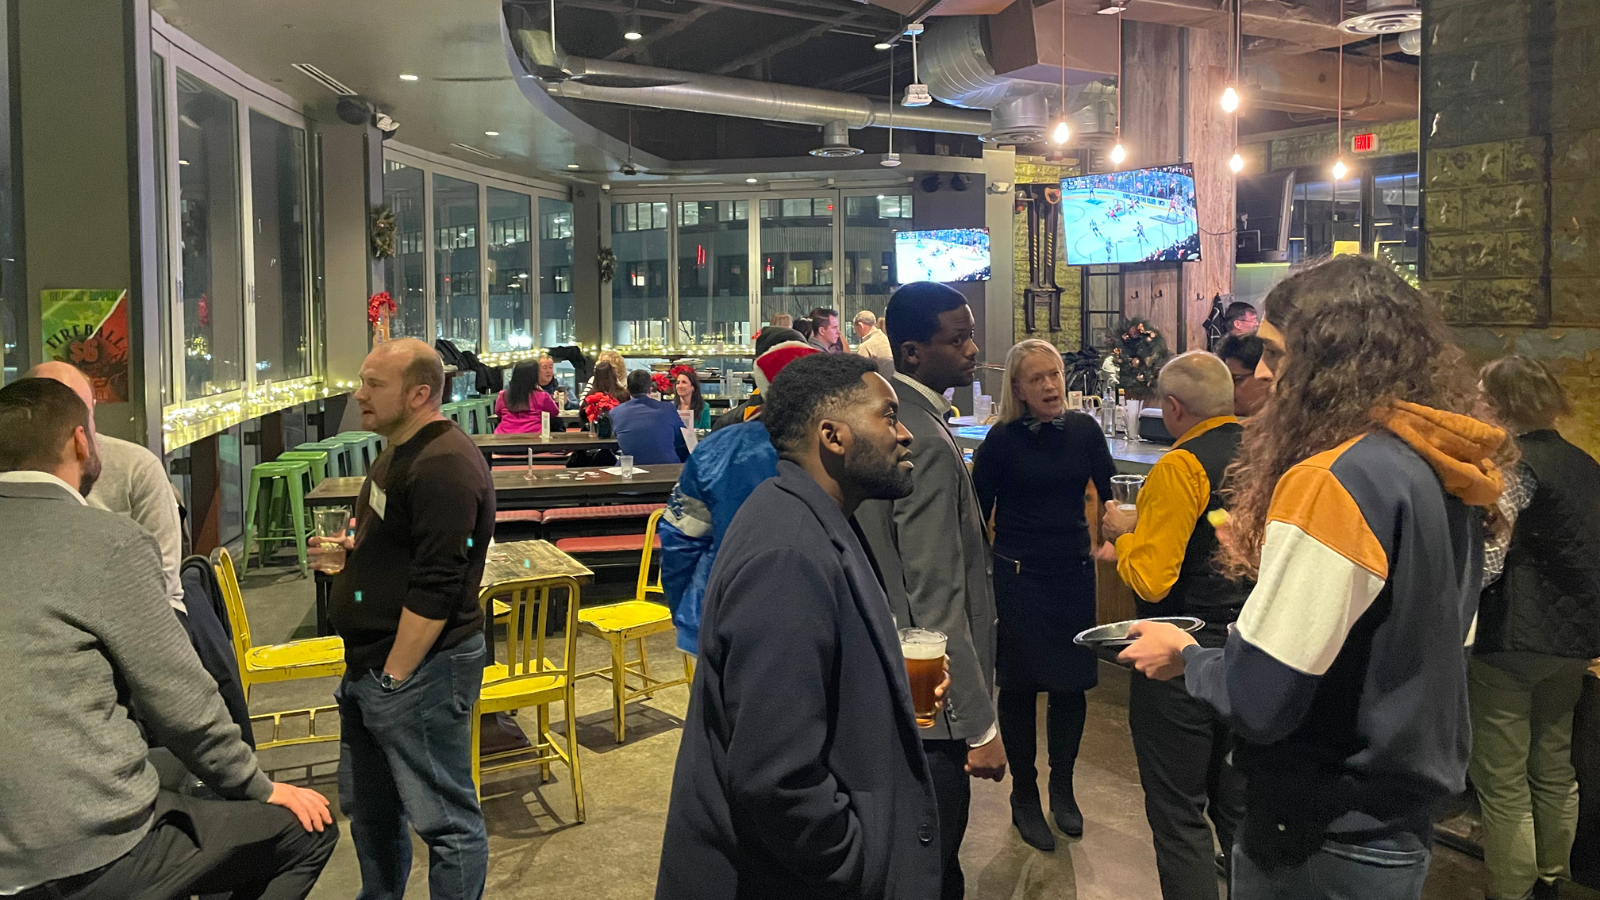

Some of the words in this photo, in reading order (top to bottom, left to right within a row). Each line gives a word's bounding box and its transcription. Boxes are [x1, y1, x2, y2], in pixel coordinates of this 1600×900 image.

[1355, 135, 1373, 150] EXIT
[45, 324, 123, 349] FIREBALL
[70, 339, 98, 363] $6
